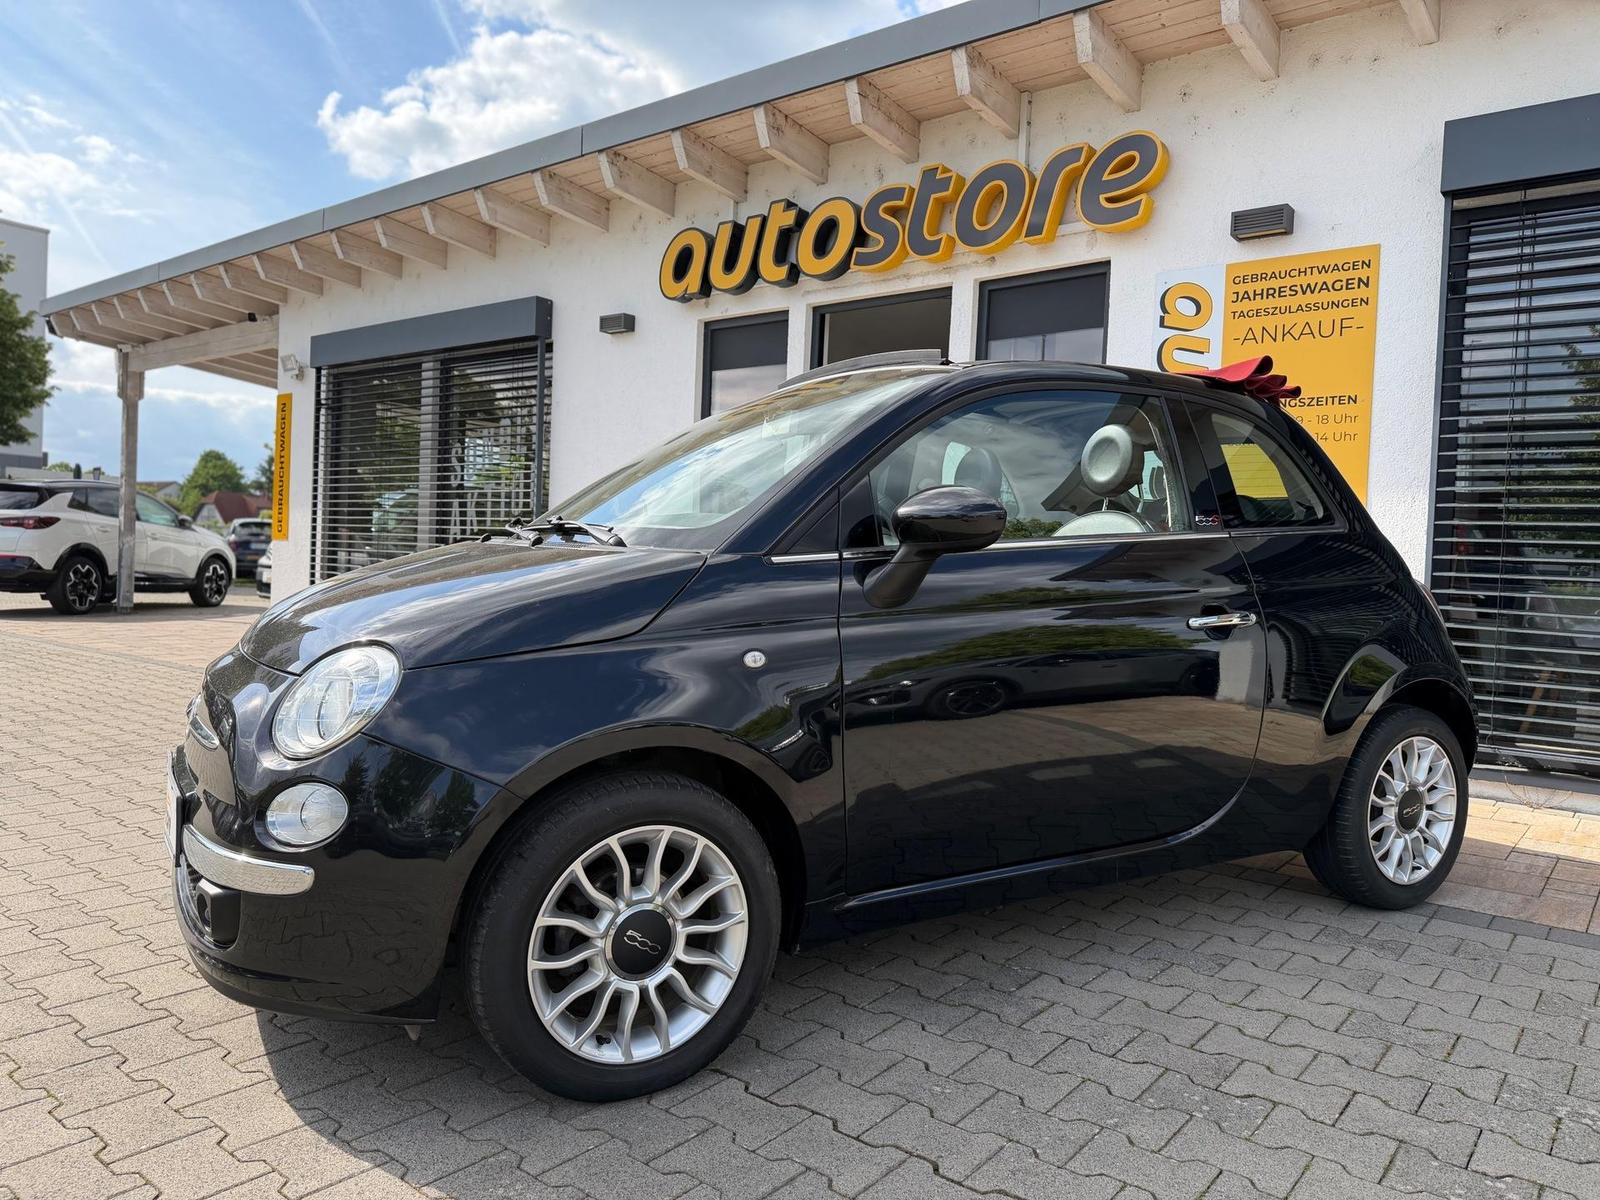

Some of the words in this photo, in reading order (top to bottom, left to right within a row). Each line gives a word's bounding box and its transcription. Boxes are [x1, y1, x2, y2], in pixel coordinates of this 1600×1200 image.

[659, 130, 1169, 302] autostore
[1232, 258, 1372, 285] GEBRAUCHTWAGEN
[1231, 276, 1371, 304] JAHRESWAGEN
[1231, 296, 1370, 320] TAGESZULASSUNGEN
[1315, 414, 1330, 425] 18
[1333, 412, 1359, 424] Uhr
[1315, 432, 1328, 442] 14
[1333, 431, 1359, 442] Uhr
[277, 402, 287, 533] GEBRAUCHTWAGEN
